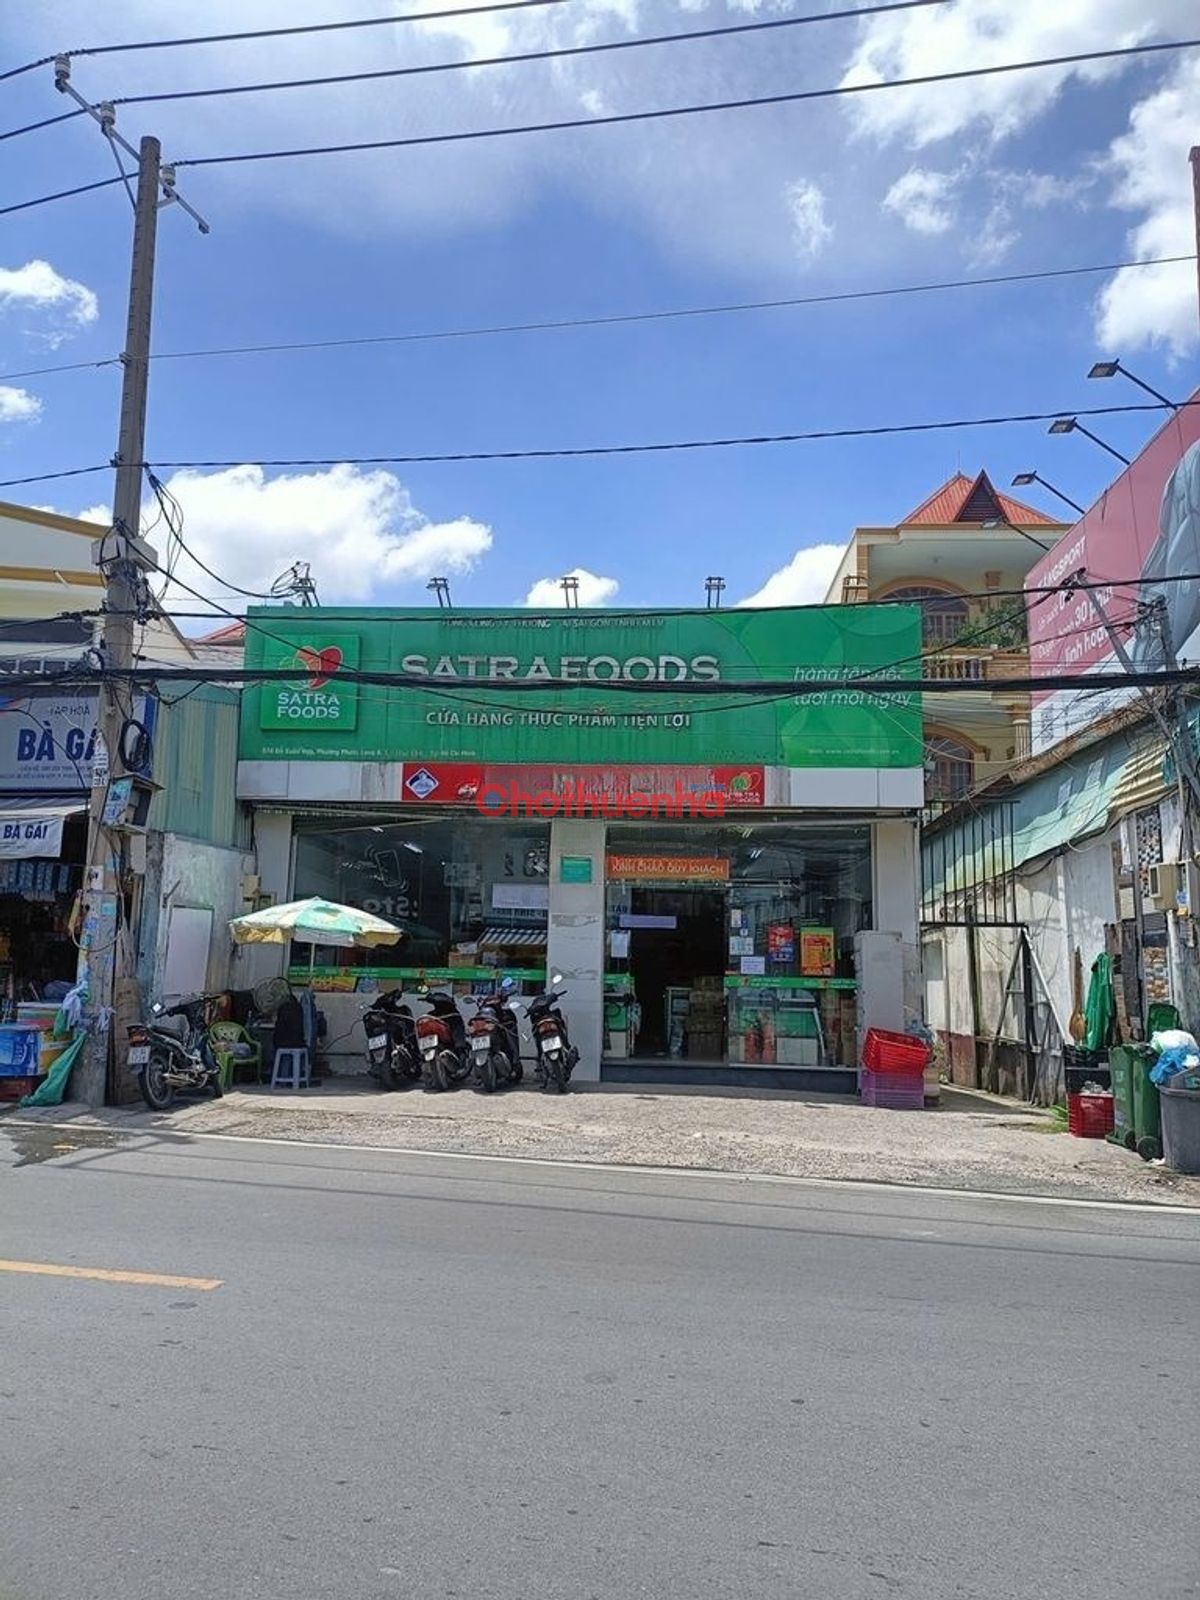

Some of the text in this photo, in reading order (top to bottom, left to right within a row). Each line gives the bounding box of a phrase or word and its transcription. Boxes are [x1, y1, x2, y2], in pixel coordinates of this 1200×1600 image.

[277, 692, 340, 705] SATRA
[277, 706, 340, 719] FOODS
[17, 720, 55, 761] BÀ
